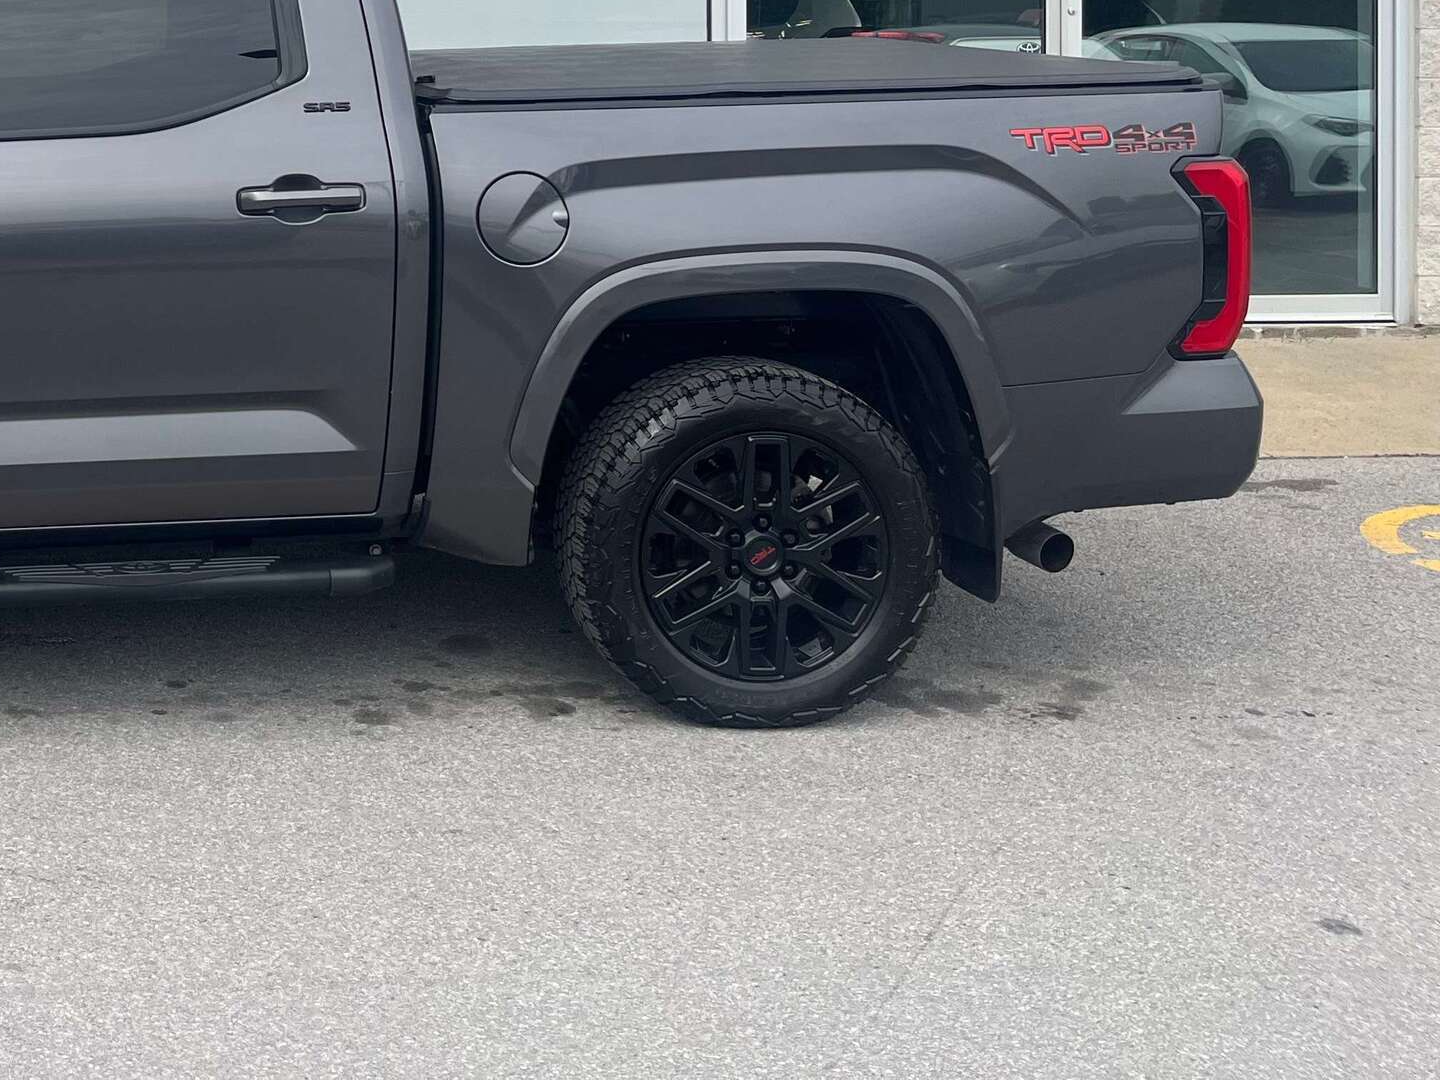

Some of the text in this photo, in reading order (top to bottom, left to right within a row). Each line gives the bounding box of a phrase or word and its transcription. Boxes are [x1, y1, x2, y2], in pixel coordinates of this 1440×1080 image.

[303, 101, 352, 113] SR5
[1009, 124, 1112, 157] TRD
[1115, 140, 1198, 155] SPORT
